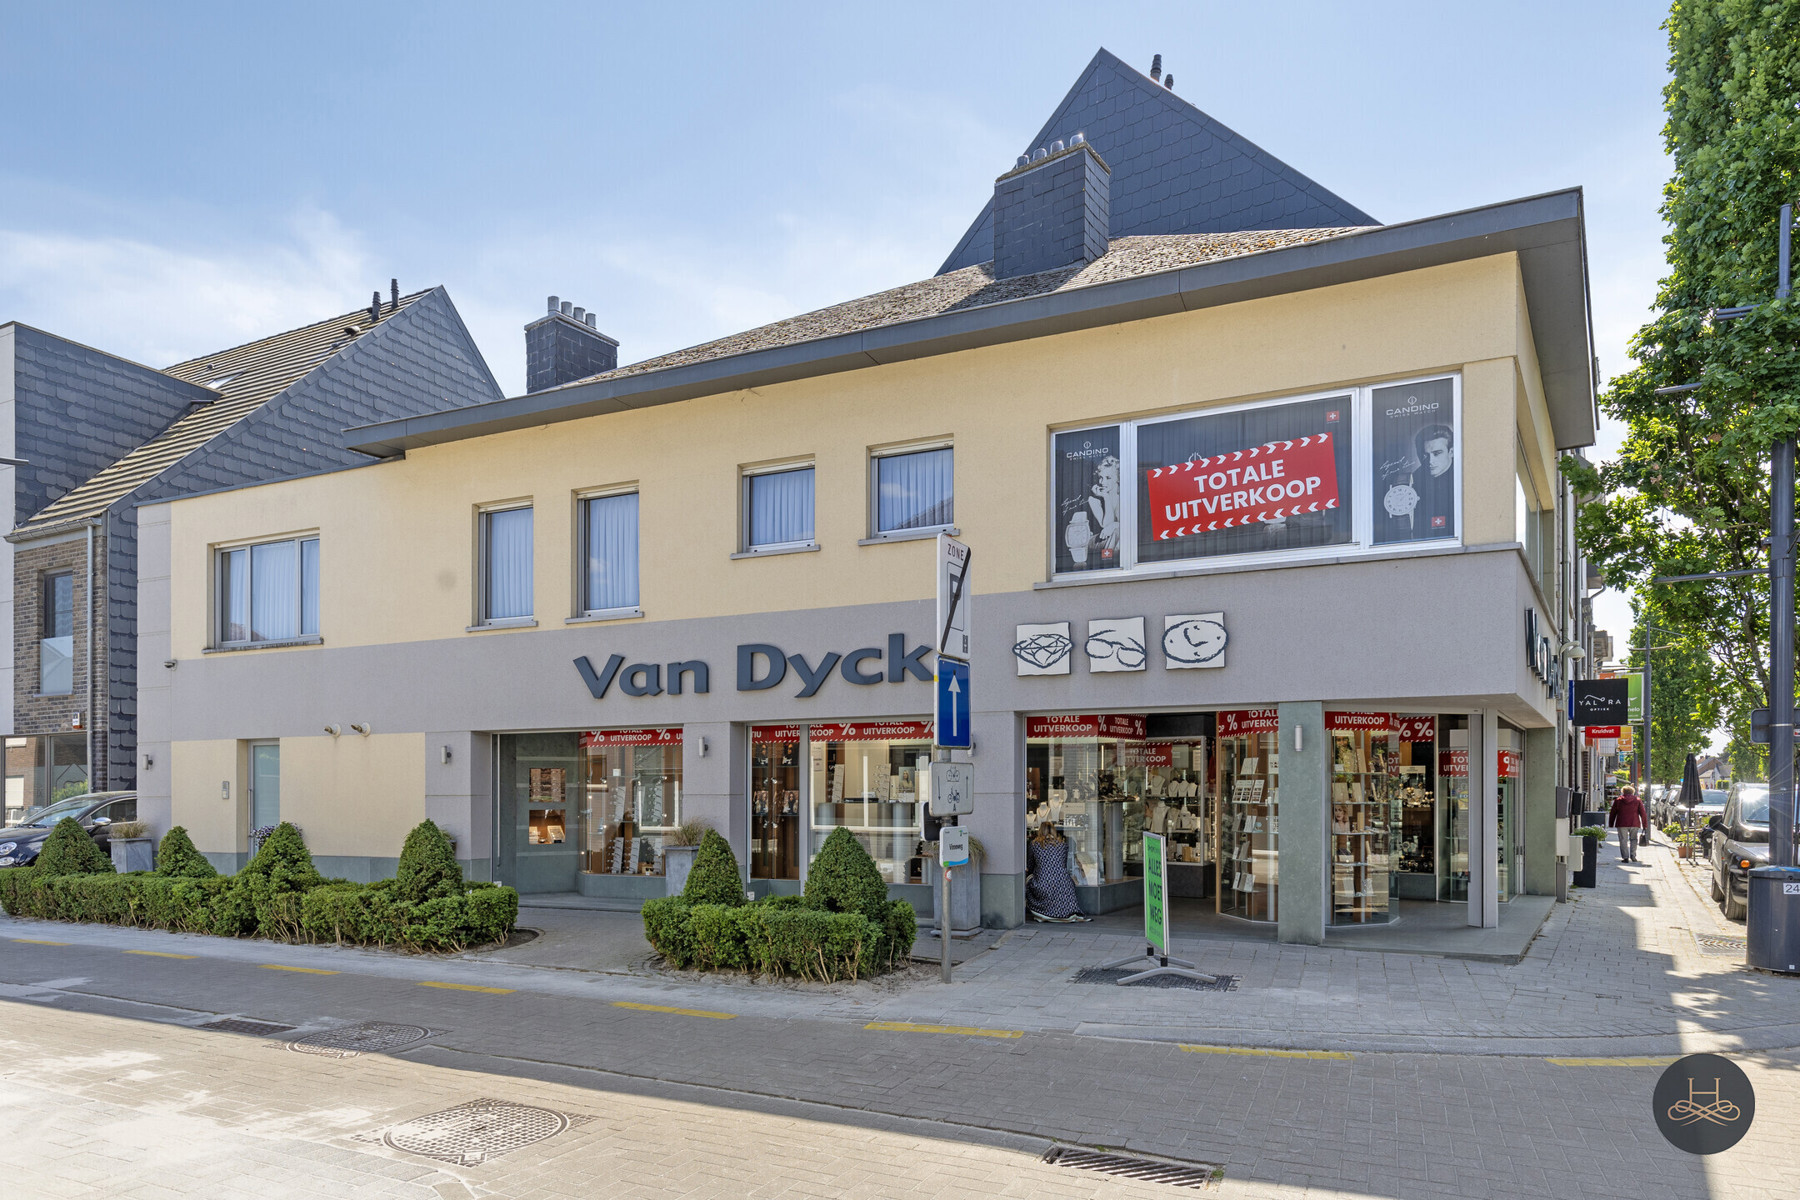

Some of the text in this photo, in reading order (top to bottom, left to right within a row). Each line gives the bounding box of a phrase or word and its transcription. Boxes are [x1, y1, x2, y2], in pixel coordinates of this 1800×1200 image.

[1386, 402, 1439, 416] CANDINO
[1066, 447, 1109, 458] CANDINO
[1193, 459, 1285, 493] TOTALE
[1165, 476, 1322, 522] UITVERKOOP
[947, 543, 964, 561] ZONE
[573, 633, 934, 699] Van Dyck
[1045, 715, 1080, 723] TOTALE
[1114, 716, 1129, 726] TOTALE
[1226, 713, 1238, 731] %
[1247, 709, 1279, 718] TOTAL
[1334, 715, 1385, 726] UITVERKOOP
[863, 726, 915, 735] UITVERKOOP
[1033, 724, 1093, 733] UITVERKOOP
[1109, 725, 1134, 735] UITVERKOOP
[1414, 721, 1434, 737] %
[610, 733, 652, 742] UITVERKOOP
[1148, 857, 1162, 878] ALLES
[1148, 879, 1163, 902] MOET
[1785, 884, 1800, 893] 24
[1149, 903, 1162, 926] WEG
